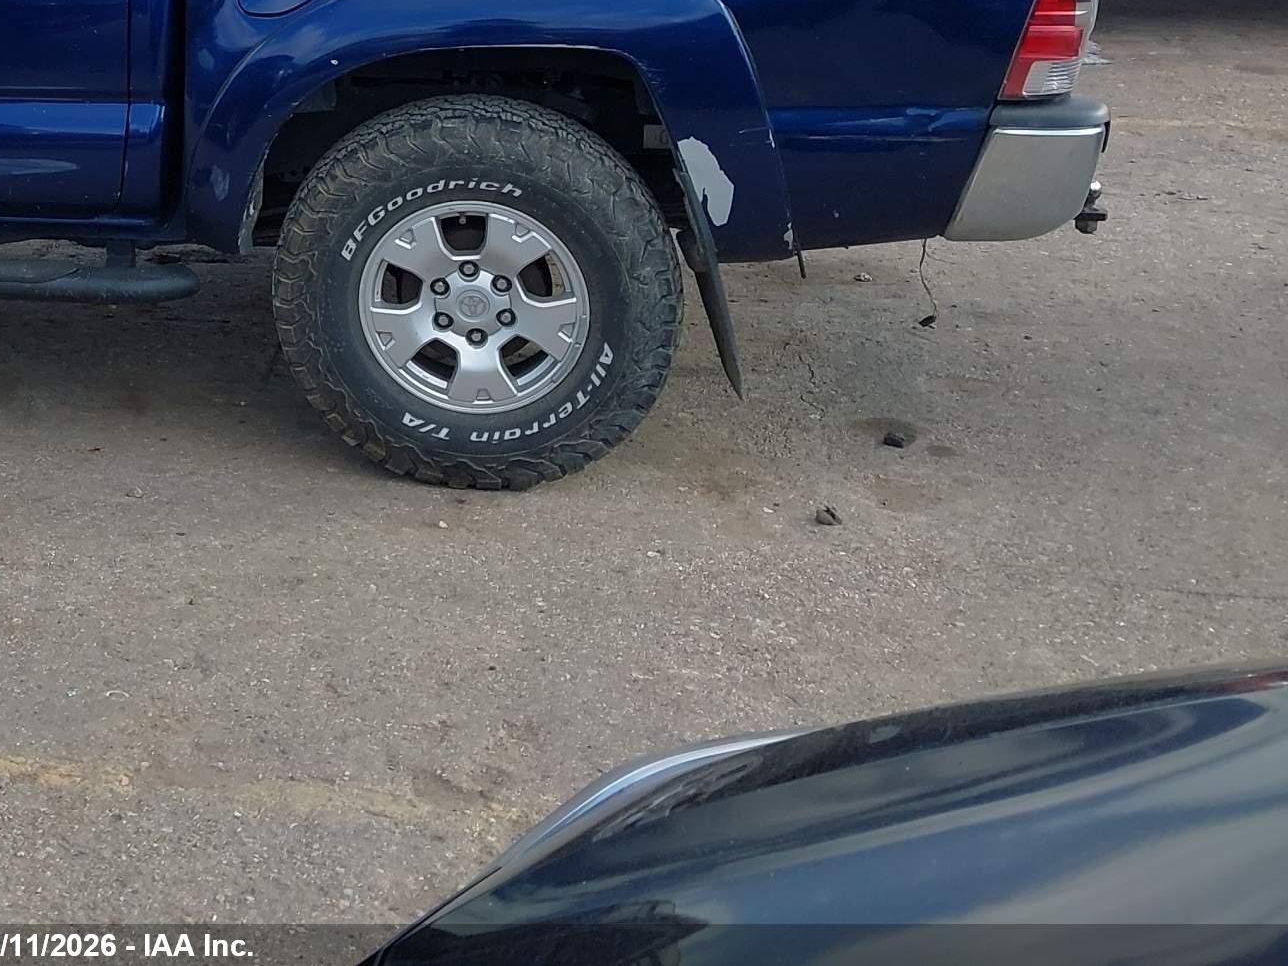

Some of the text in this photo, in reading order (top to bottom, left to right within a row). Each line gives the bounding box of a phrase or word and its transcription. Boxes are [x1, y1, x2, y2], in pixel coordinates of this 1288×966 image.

[340, 178, 524, 262] BFGoodrich
[401, 341, 615, 445] All-Terrain T/A
